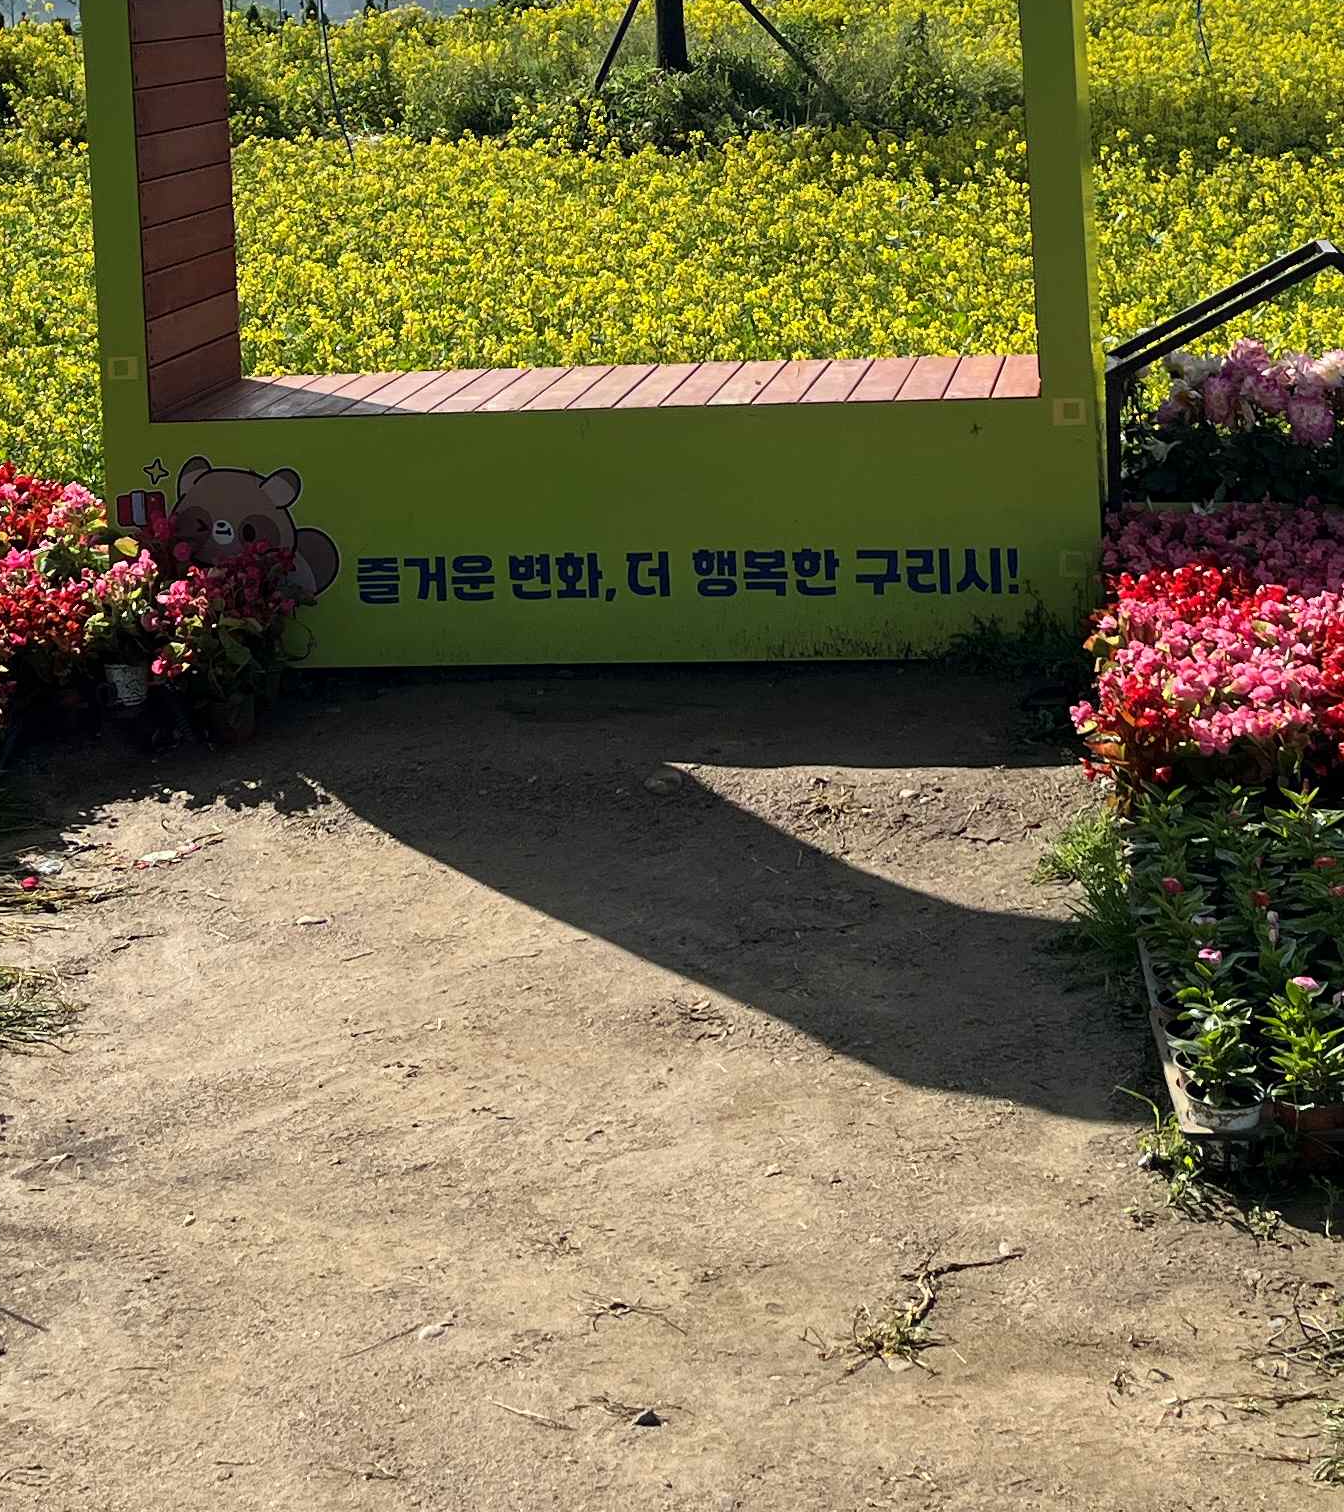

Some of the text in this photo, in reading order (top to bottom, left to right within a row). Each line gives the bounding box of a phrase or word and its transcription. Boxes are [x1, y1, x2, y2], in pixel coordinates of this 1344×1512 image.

[356, 547, 1020, 605] 즐거운 변화, 더 행복한 구리시!
